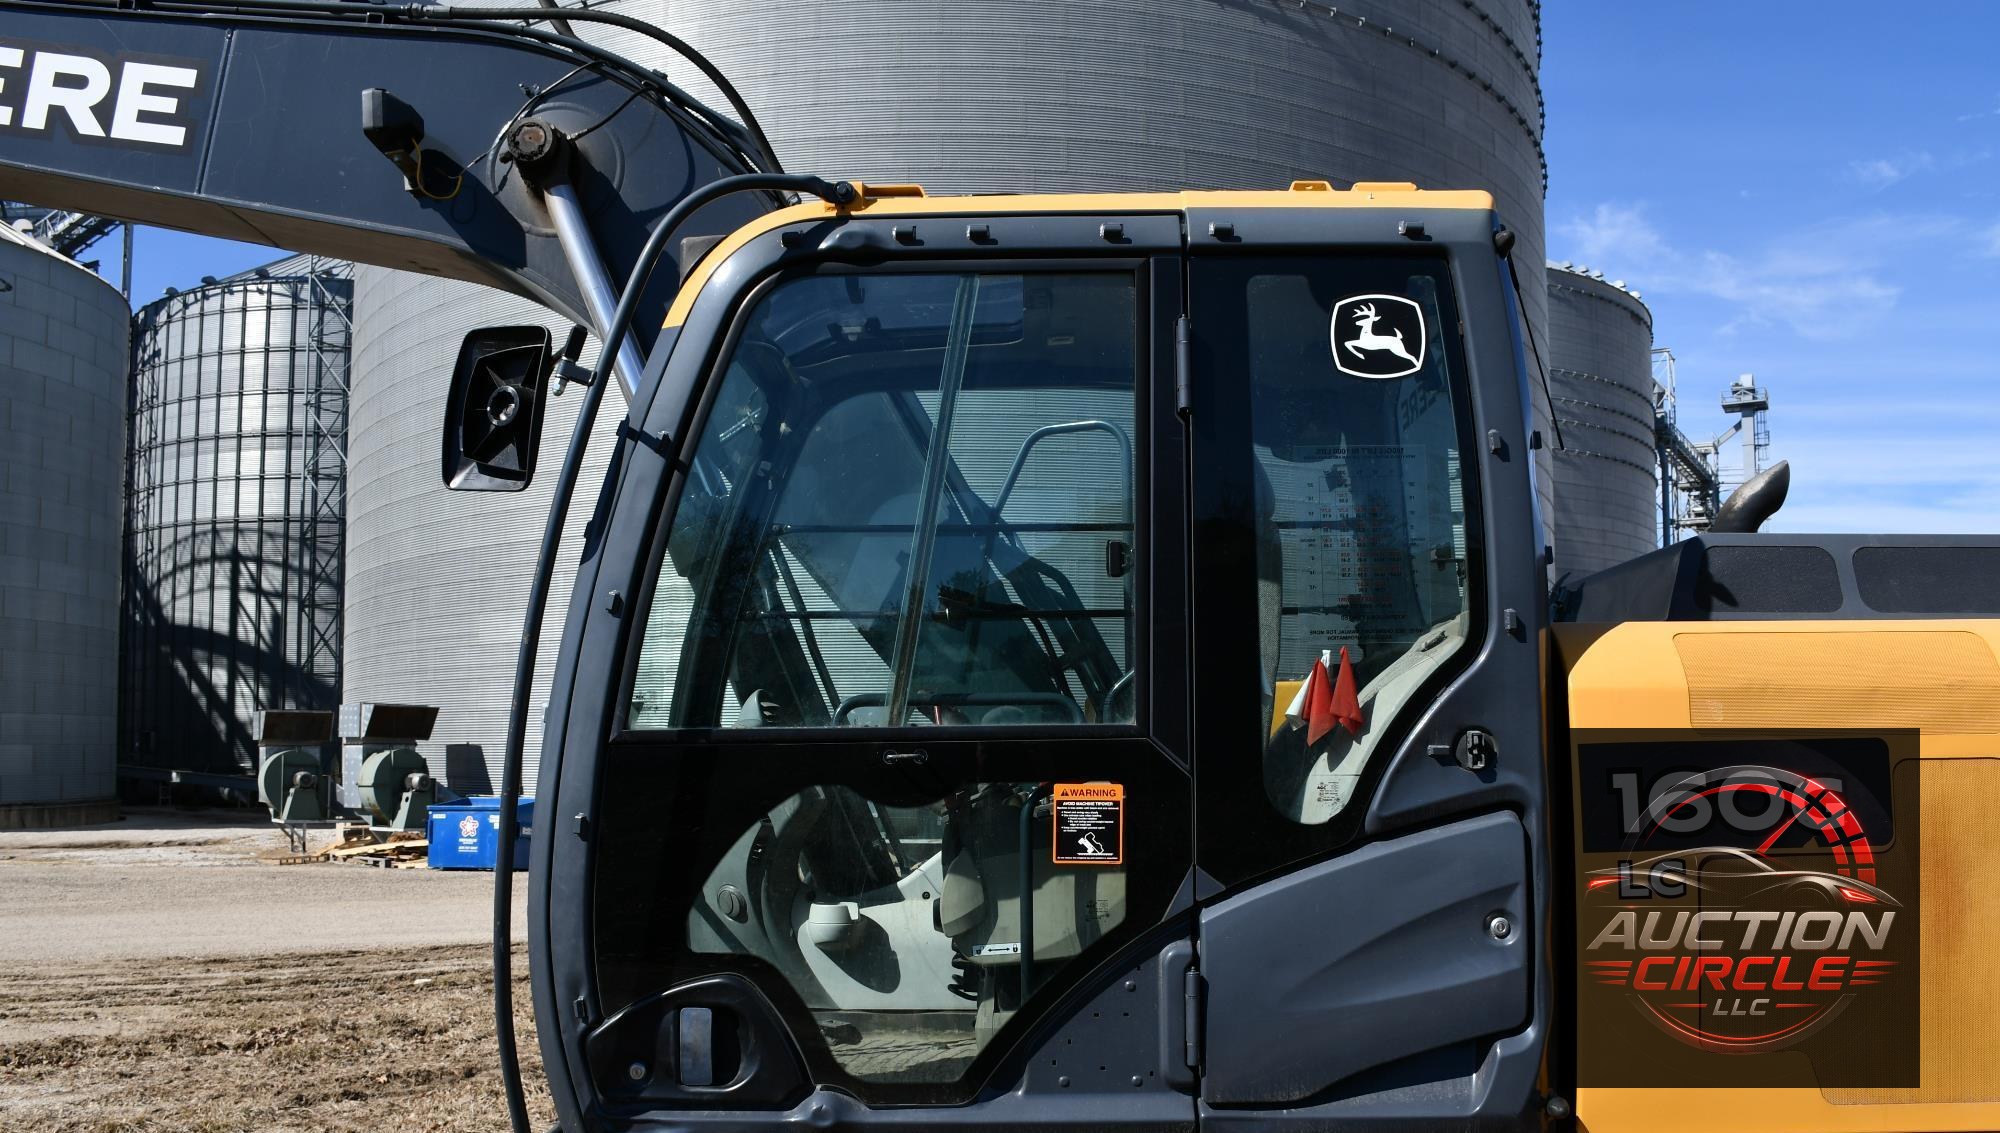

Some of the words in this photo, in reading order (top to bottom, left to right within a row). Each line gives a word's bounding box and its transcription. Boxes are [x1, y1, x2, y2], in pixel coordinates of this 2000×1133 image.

[0, 46, 198, 146] RE
[1070, 789, 1117, 797] WARNING
[1620, 861, 1684, 898] LC
